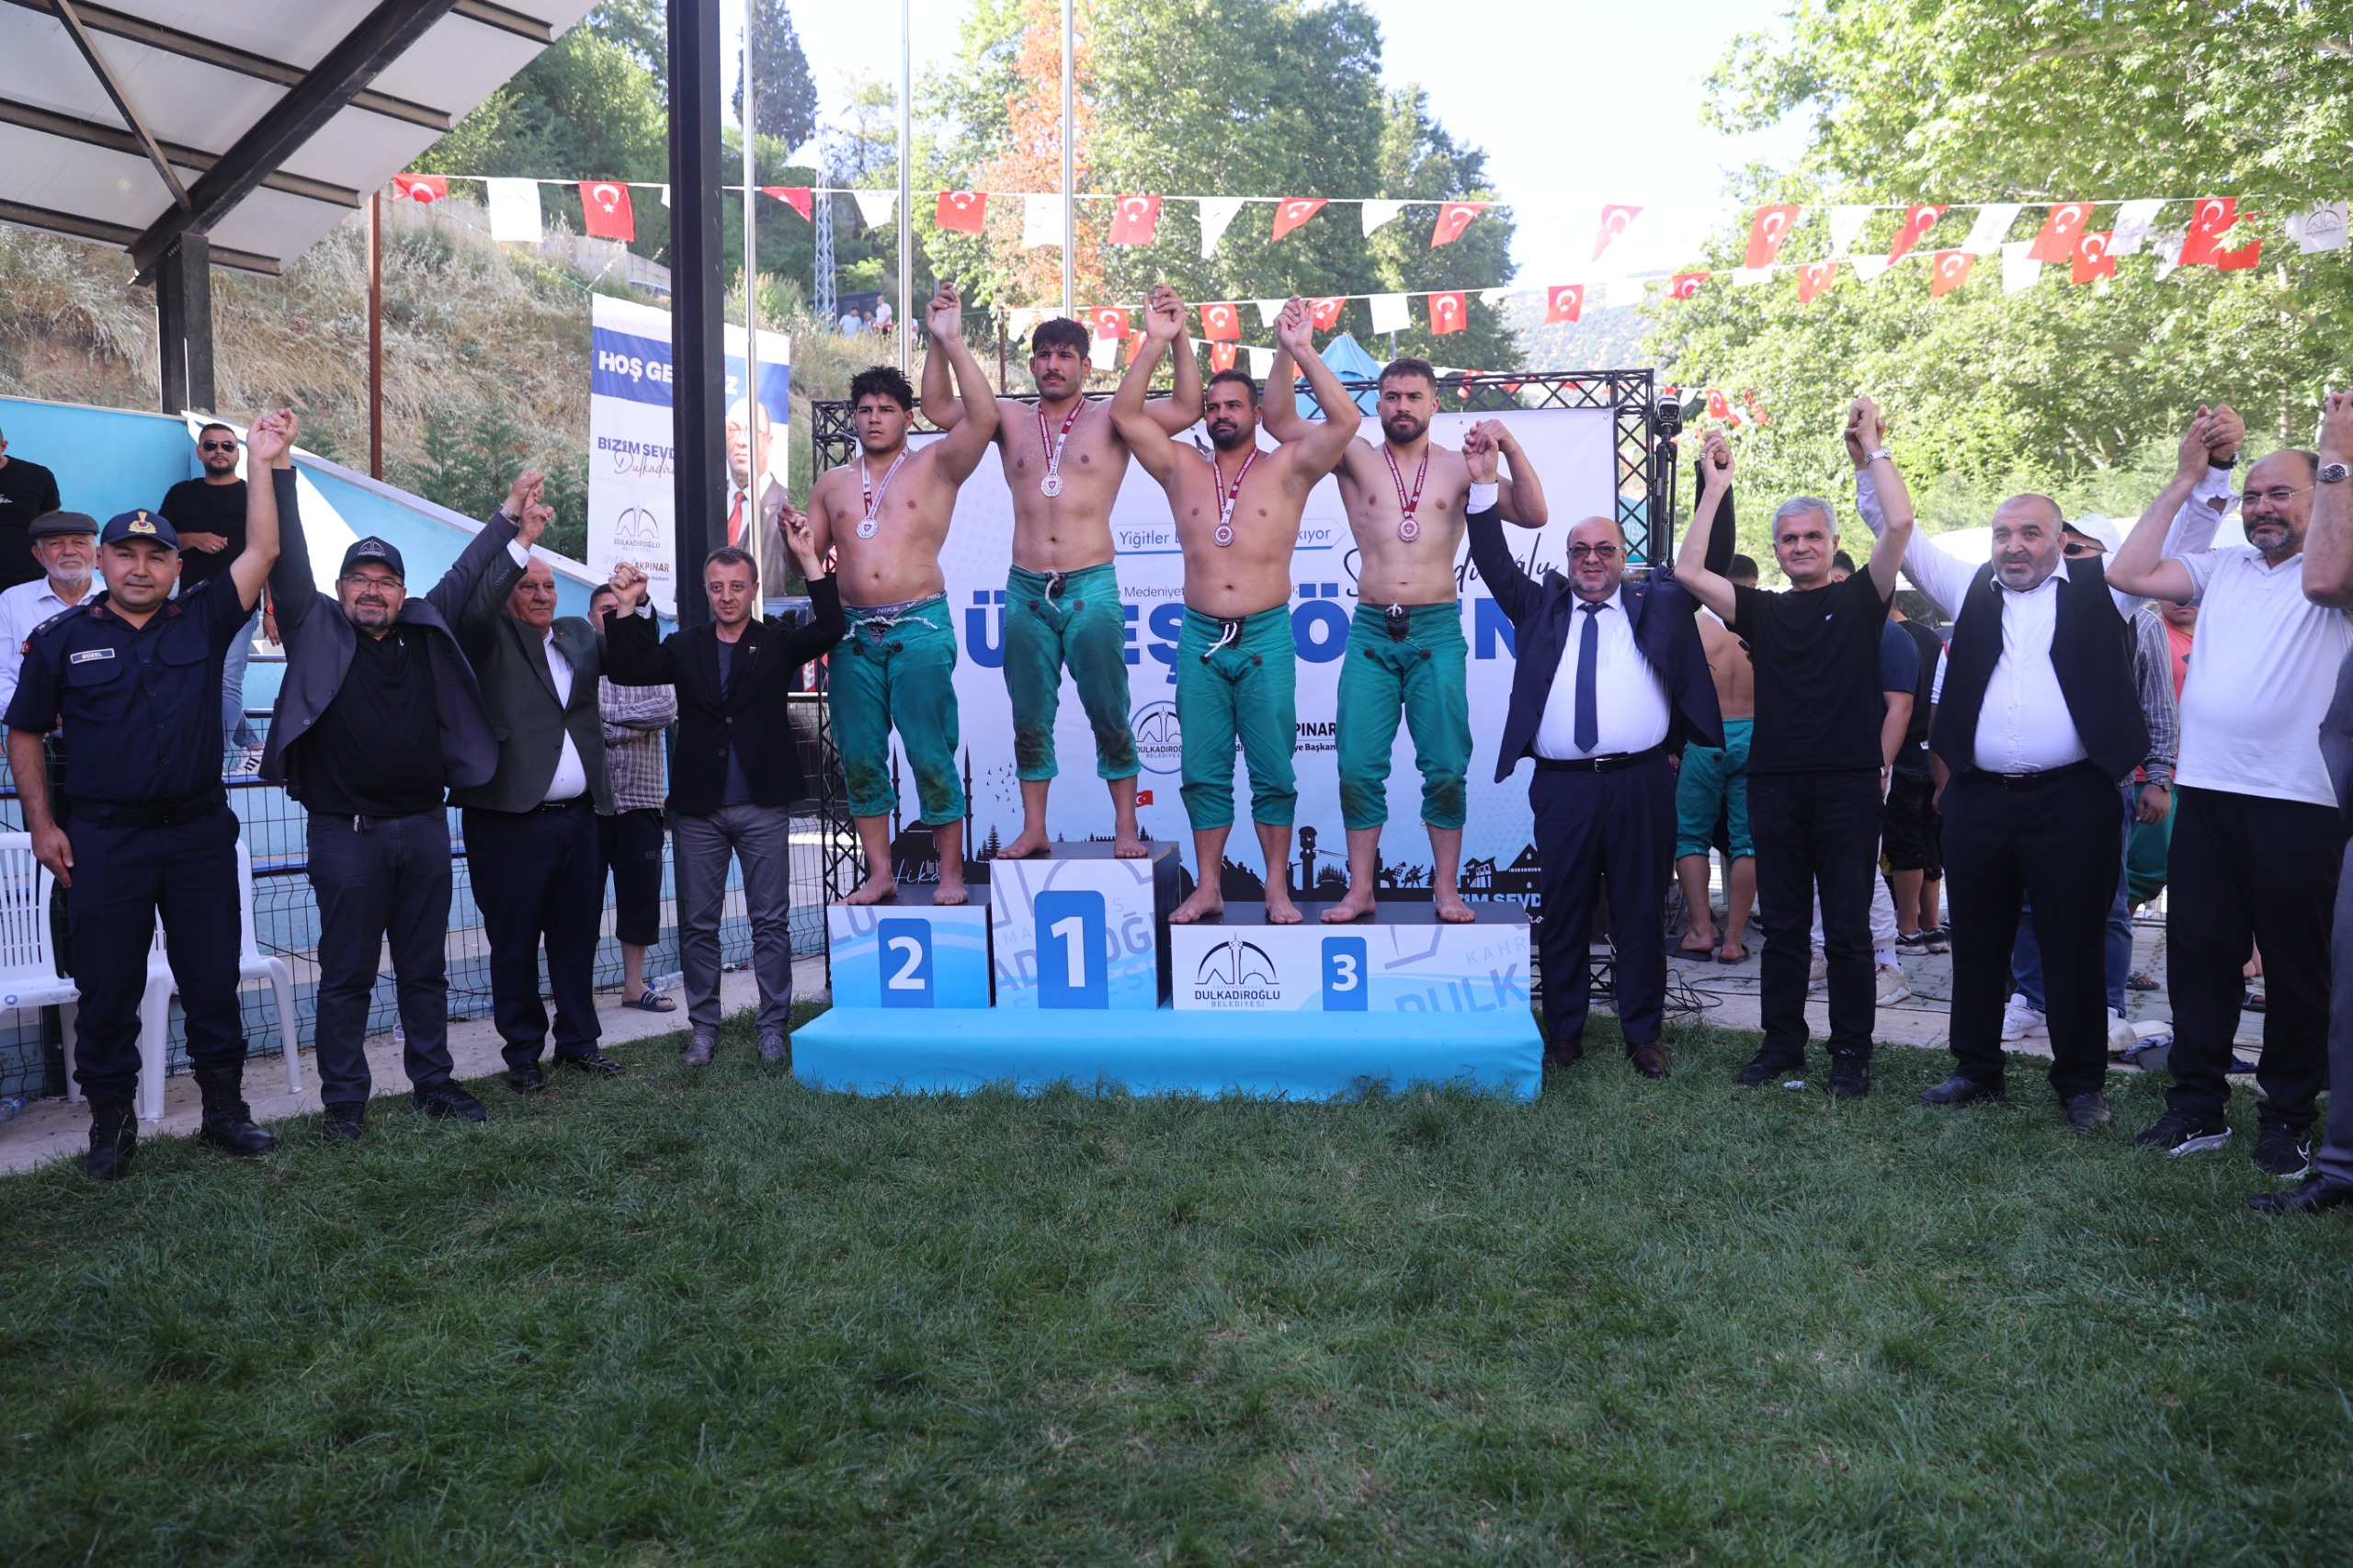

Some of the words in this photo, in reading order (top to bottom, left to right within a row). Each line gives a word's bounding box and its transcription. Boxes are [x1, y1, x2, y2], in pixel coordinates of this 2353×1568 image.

[598, 349, 643, 383] HOŞ
[642, 443, 675, 460] SEVD
[1119, 529, 1170, 549] Yiğitler
[1298, 529, 1331, 544] kıyor
[634, 562, 670, 573] AKPINAR
[1124, 585, 1185, 599] Medeniyet
[876, 606, 899, 614] NIKE
[1296, 722, 1336, 737] PINAR
[1305, 743, 1336, 753] Başkan
[1050, 915, 1086, 988] 1
[887, 936, 926, 990] 2
[1331, 953, 1358, 992] 3
[1194, 989, 1280, 1000] DULKADİROĞLU
